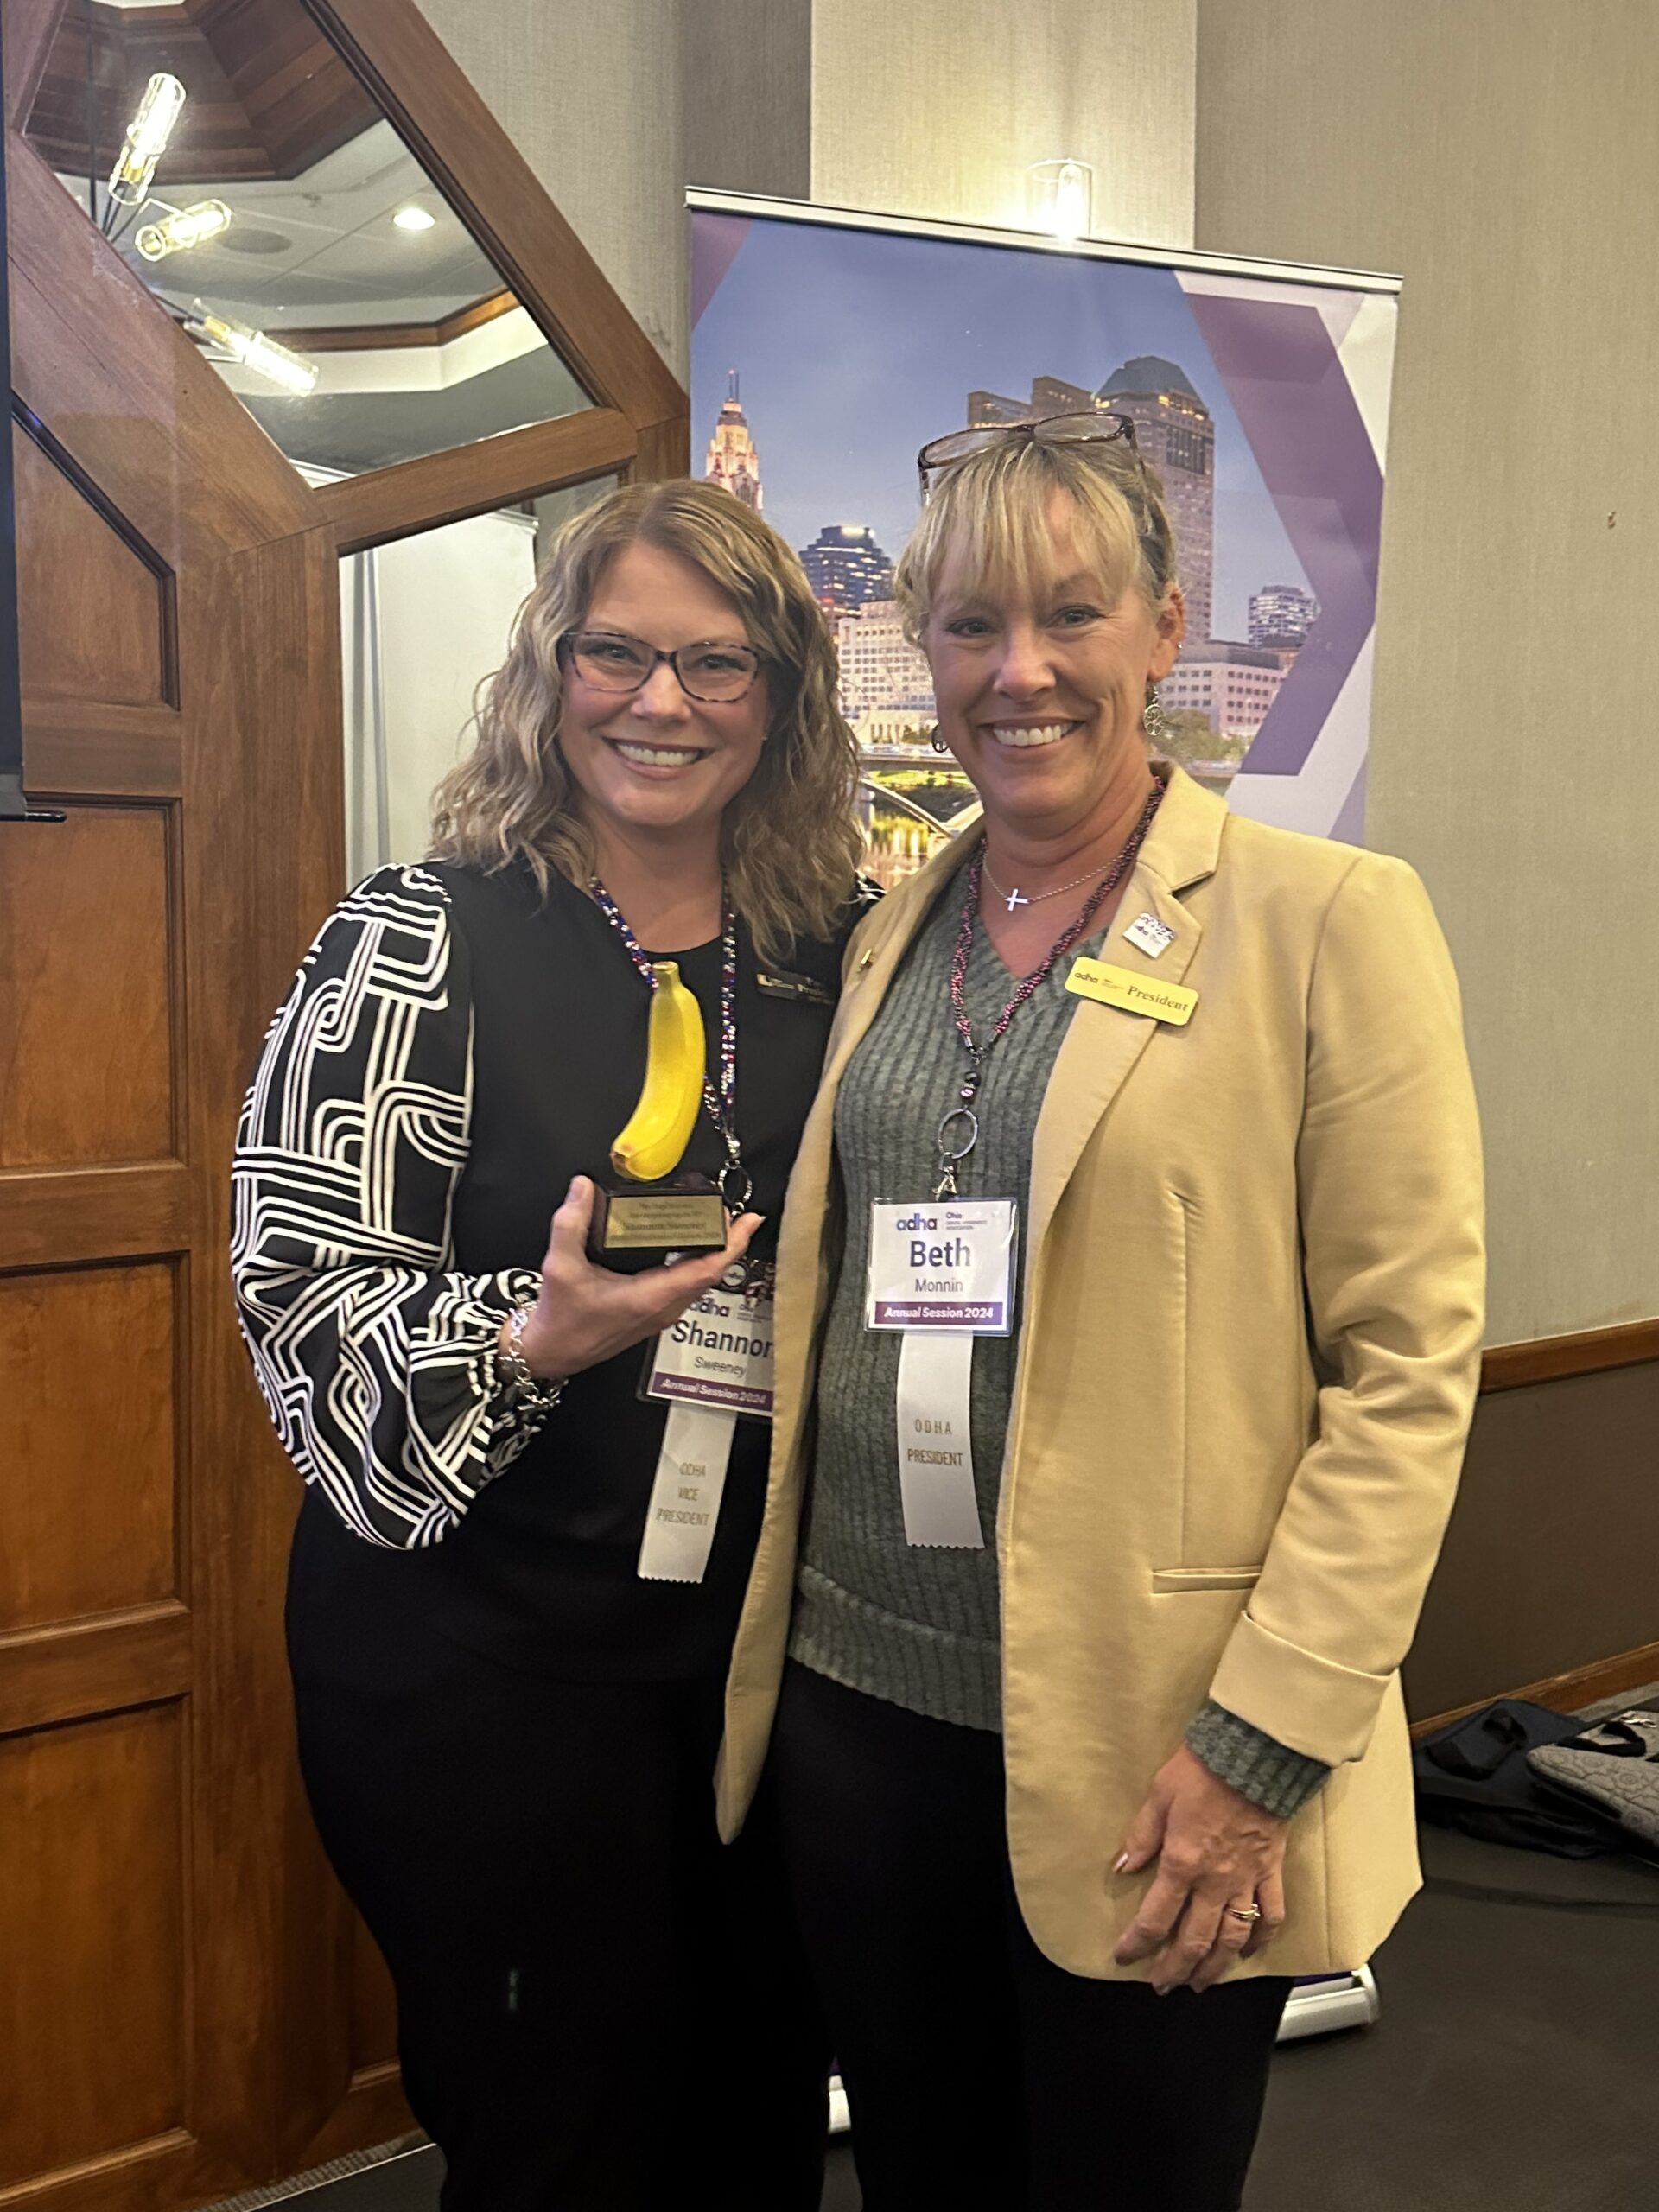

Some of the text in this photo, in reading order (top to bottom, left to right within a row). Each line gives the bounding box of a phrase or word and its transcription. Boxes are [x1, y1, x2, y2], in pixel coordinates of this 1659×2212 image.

[1074, 972, 1098, 984] adha
[1127, 985, 1190, 1012] President
[896, 1212, 938, 1231] adha
[910, 1237, 971, 1268] Beth
[915, 1278, 963, 1293] Monnin
[884, 1306, 994, 1319] Annual Session 2024
[694, 1356, 747, 1378] Sweeney
[660, 1378, 767, 1404] Annual Session 2024
[914, 1418, 953, 1435] ODHA
[907, 1448, 963, 1466] PRESIDENT
[678, 1486, 700, 1502] VICE
[656, 1507, 710, 1526] PRESIDENT
